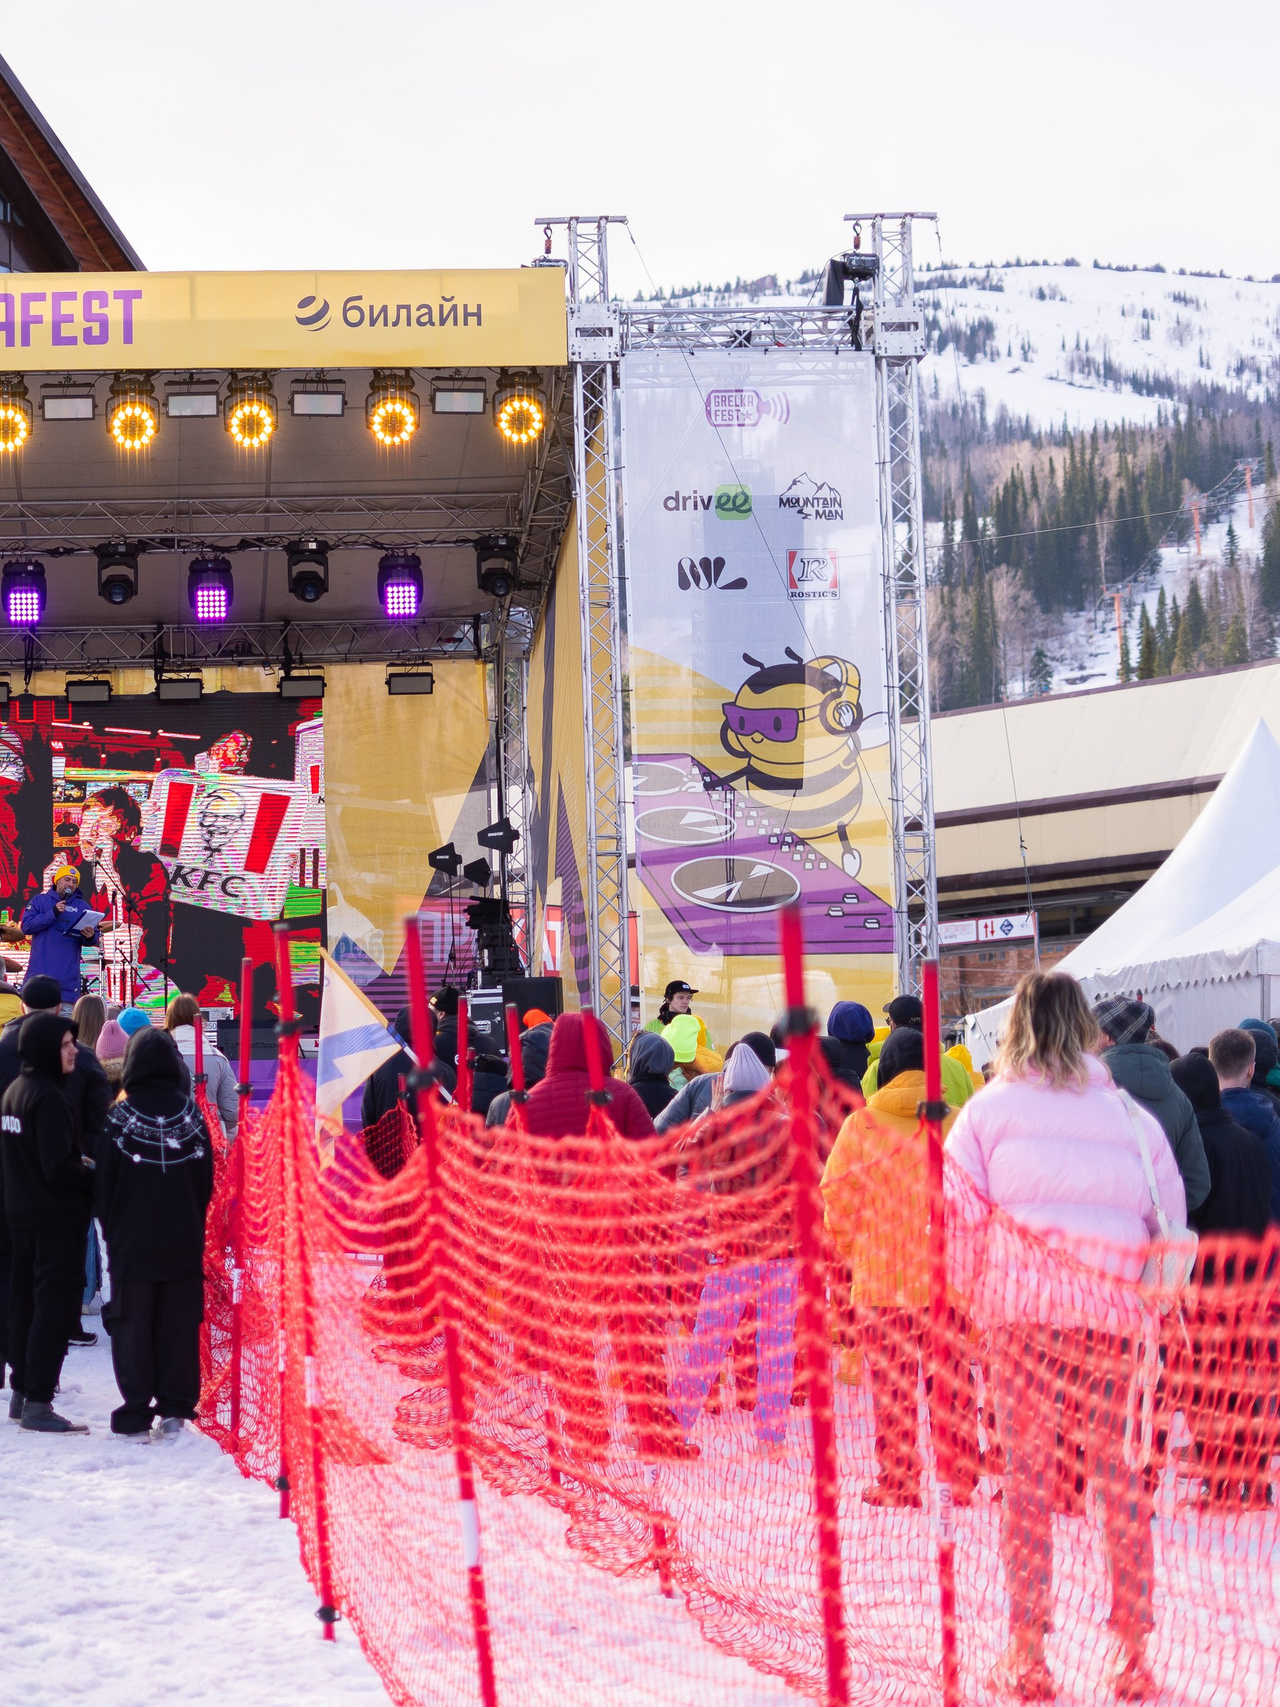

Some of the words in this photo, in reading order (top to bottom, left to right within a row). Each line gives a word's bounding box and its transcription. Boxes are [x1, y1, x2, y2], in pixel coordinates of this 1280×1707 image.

[342, 295, 482, 327] билайн
[714, 394, 754, 407] GRELKA
[714, 409, 741, 422] FEST
[663, 490, 752, 513] drivee
[779, 496, 842, 508] MOUNTAIN
[815, 509, 844, 520] MAN
[790, 590, 838, 598] ROSTIC'S
[170, 864, 246, 898] KFC
